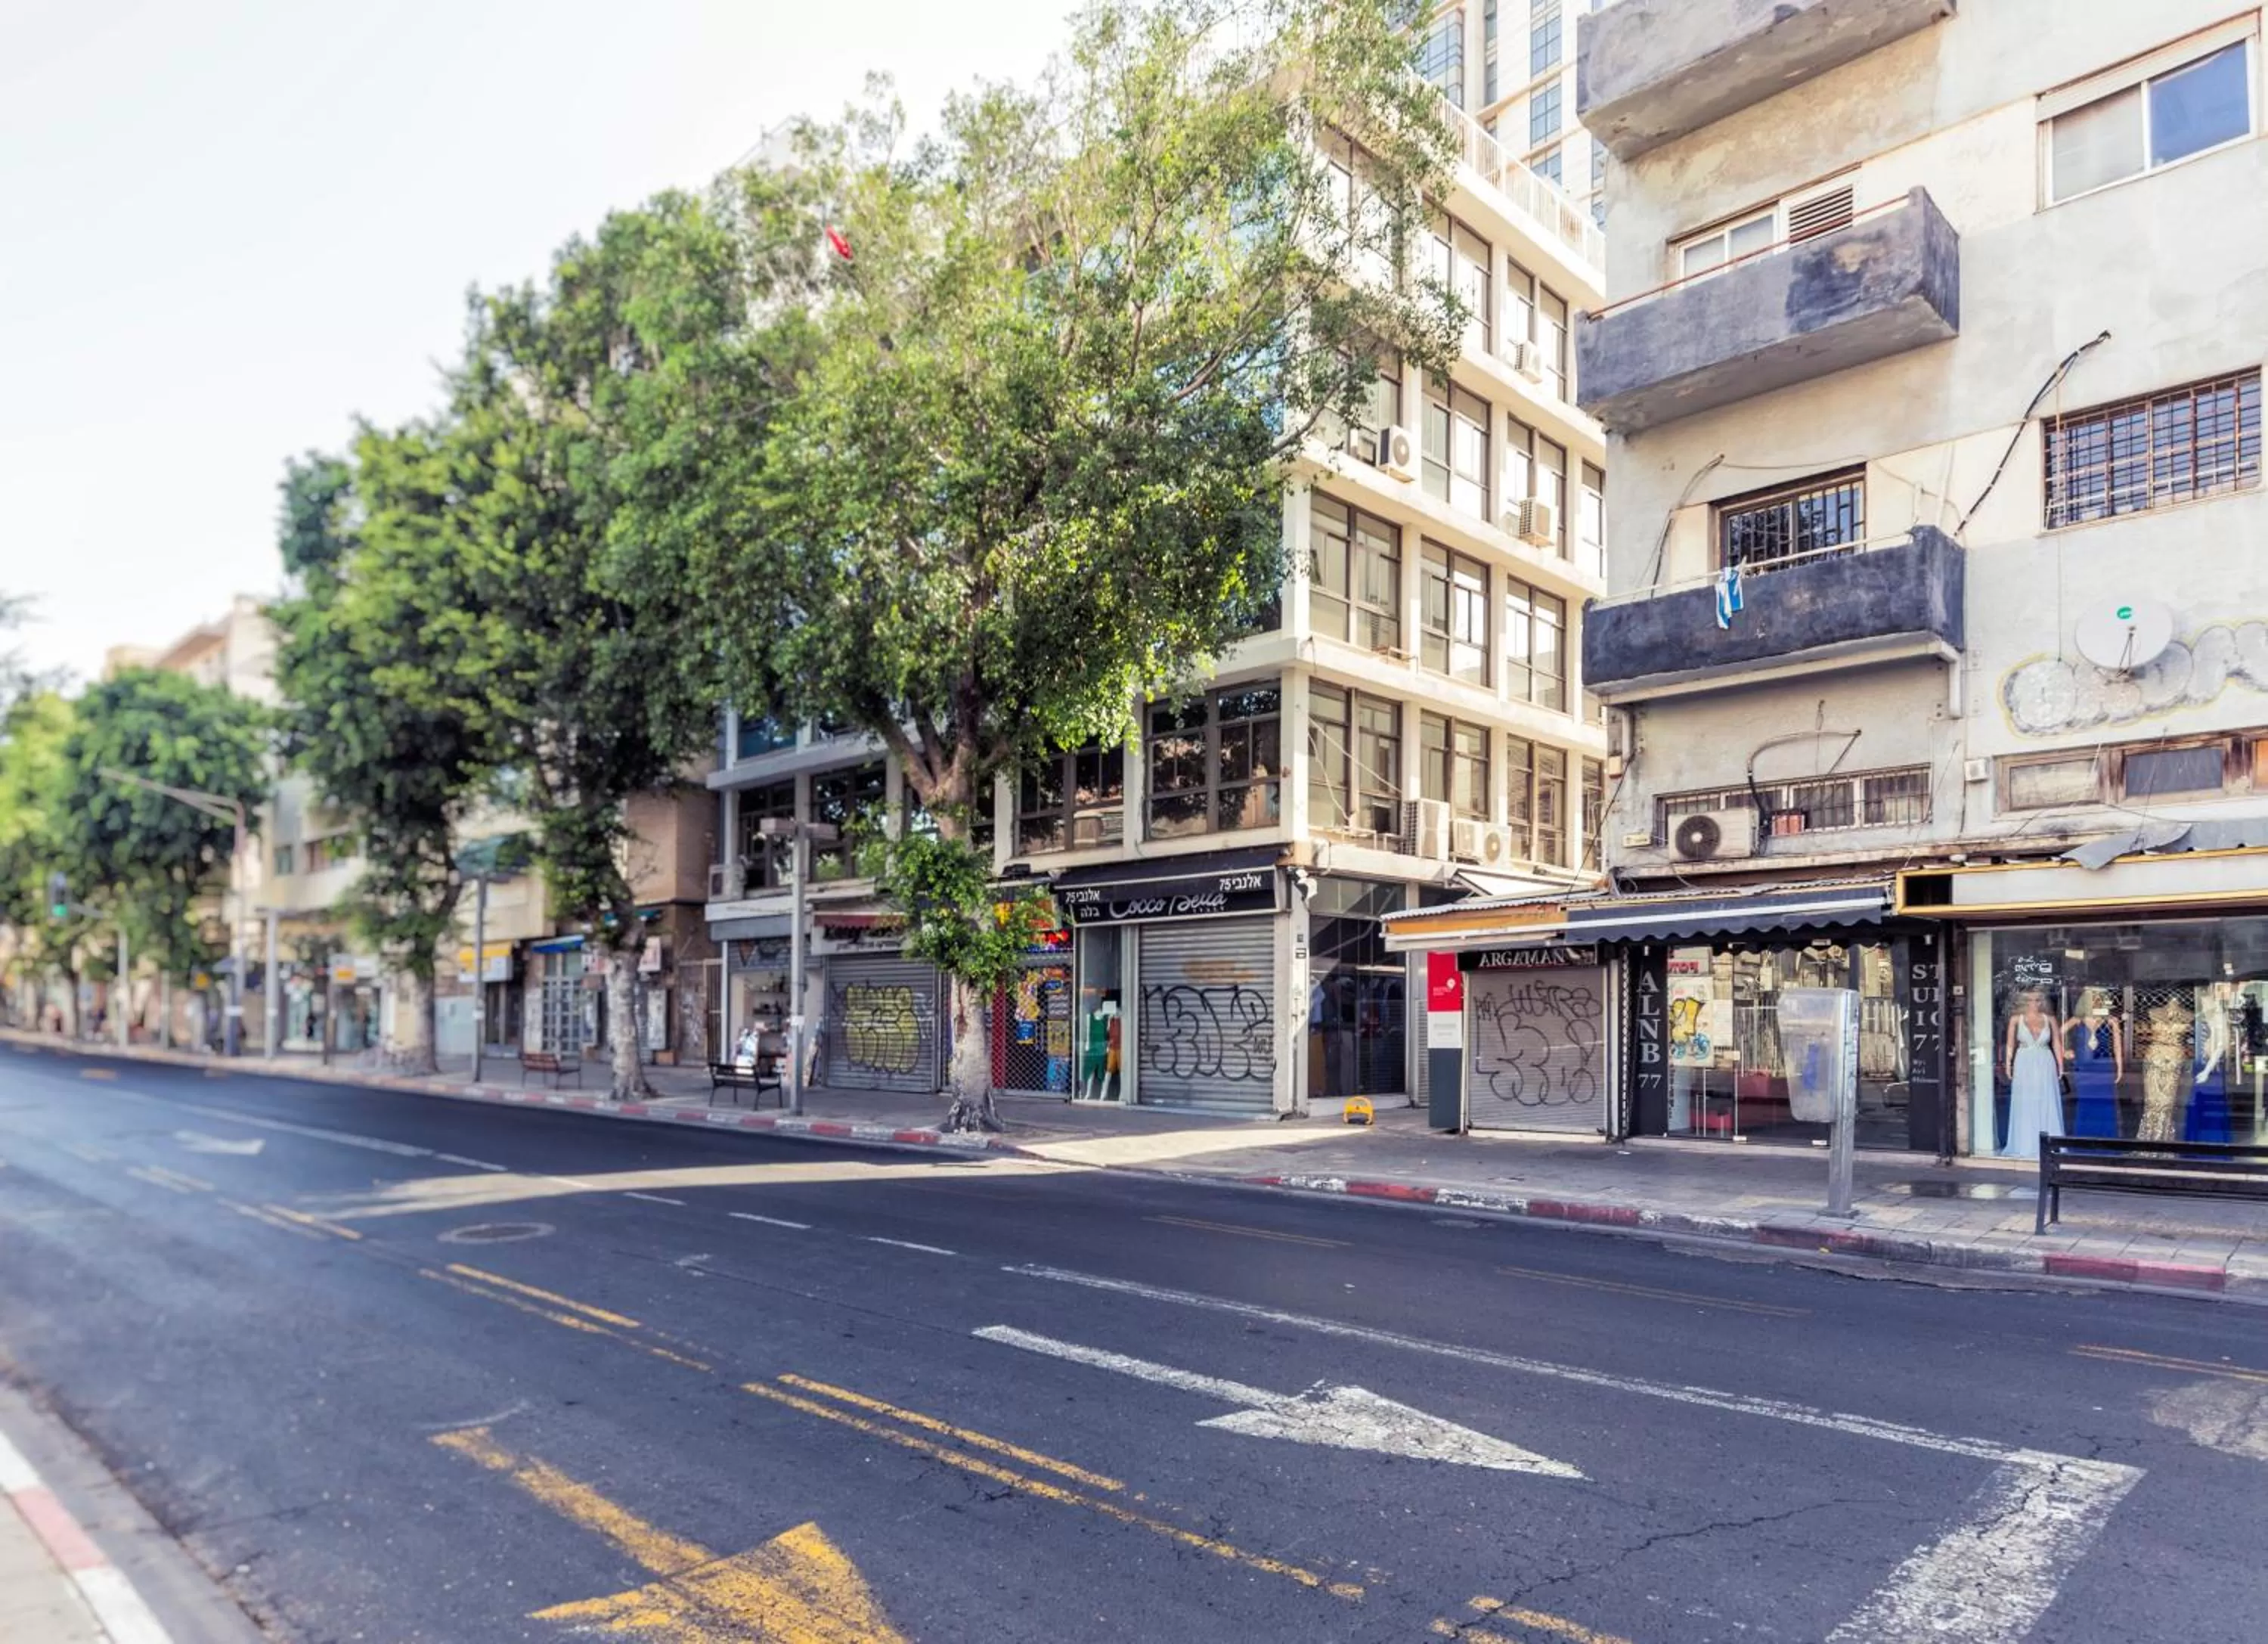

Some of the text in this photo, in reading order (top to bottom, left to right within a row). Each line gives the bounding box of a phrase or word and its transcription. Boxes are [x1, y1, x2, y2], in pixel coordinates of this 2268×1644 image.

[1219, 873, 1262, 892] אלנבי 75
[1065, 888, 1100, 904] אלנבי 75
[1637, 1074, 1662, 1089] 77
